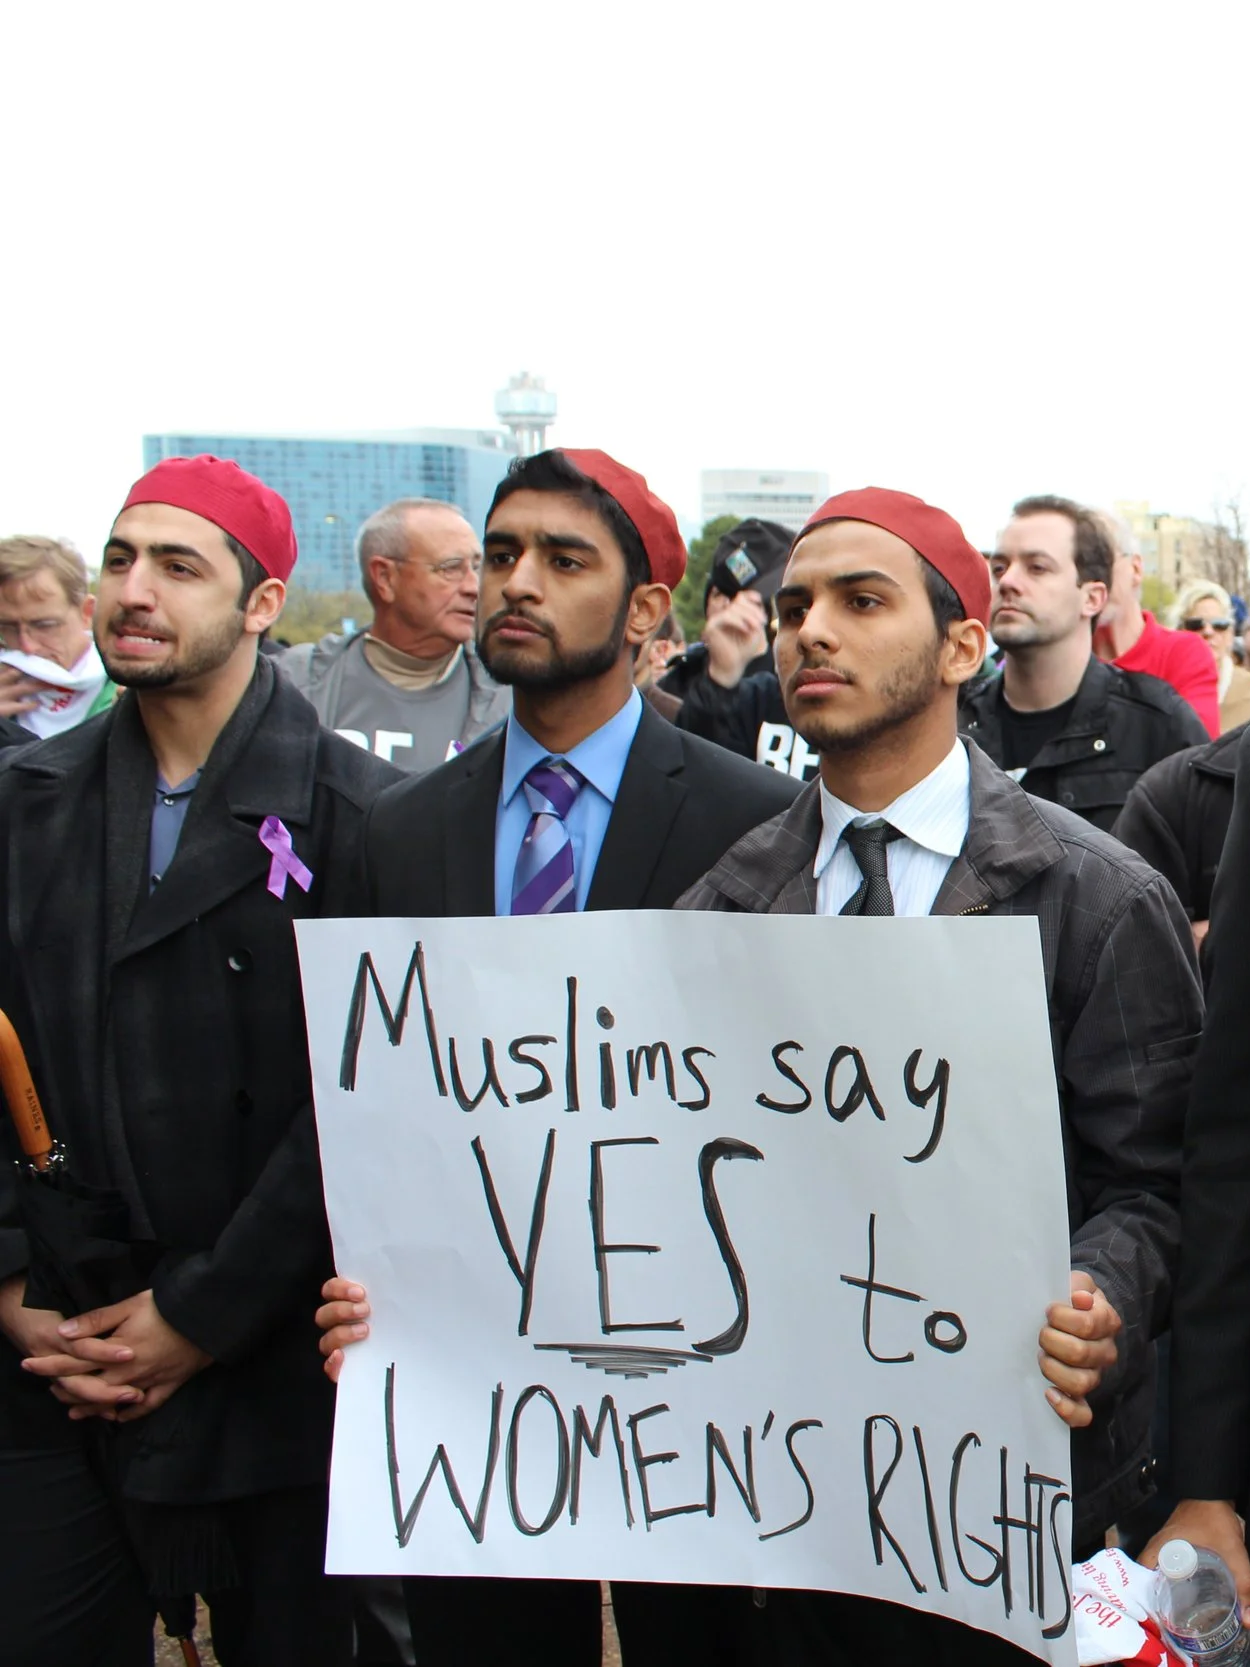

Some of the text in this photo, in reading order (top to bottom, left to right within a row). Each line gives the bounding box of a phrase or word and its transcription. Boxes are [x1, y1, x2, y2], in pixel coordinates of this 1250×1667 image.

[340, 941, 950, 1163] Muslims say
[471, 1129, 967, 1364] YES to
[385, 1362, 1071, 1639] WOMEN'S RIGHTS
[1085, 1602, 1122, 1628] the
